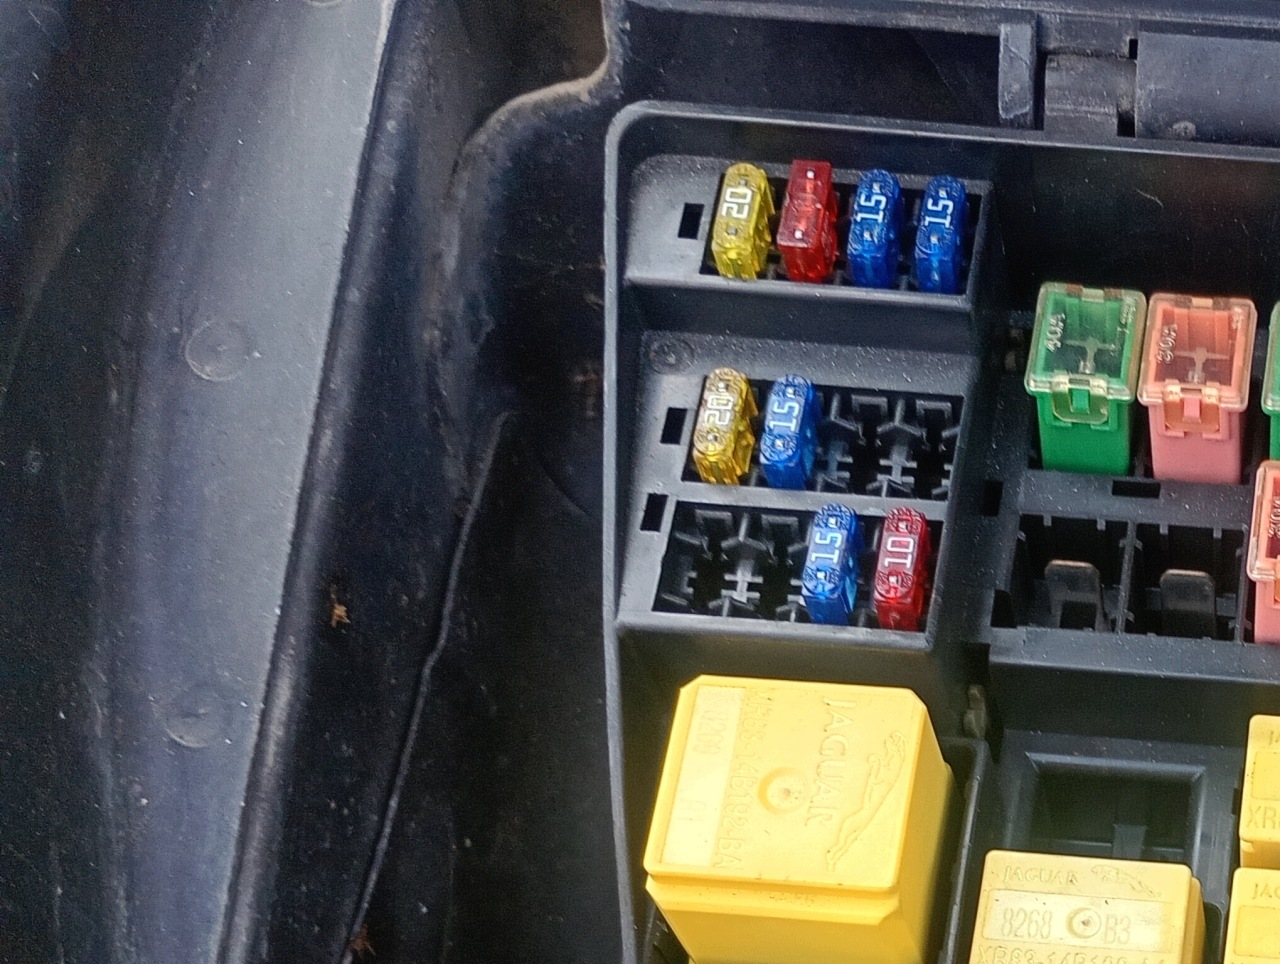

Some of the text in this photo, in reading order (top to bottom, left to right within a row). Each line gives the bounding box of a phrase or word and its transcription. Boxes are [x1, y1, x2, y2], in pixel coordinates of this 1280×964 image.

[721, 187, 753, 220] 20
[855, 191, 887, 225] 15
[923, 197, 954, 230] 15
[703, 394, 734, 427] 20
[769, 400, 800, 433] 15
[811, 531, 842, 565] 15
[884, 536, 915, 569] 10
[804, 696, 858, 828] JAGUAR
[1003, 865, 1079, 887] JAGUAR
